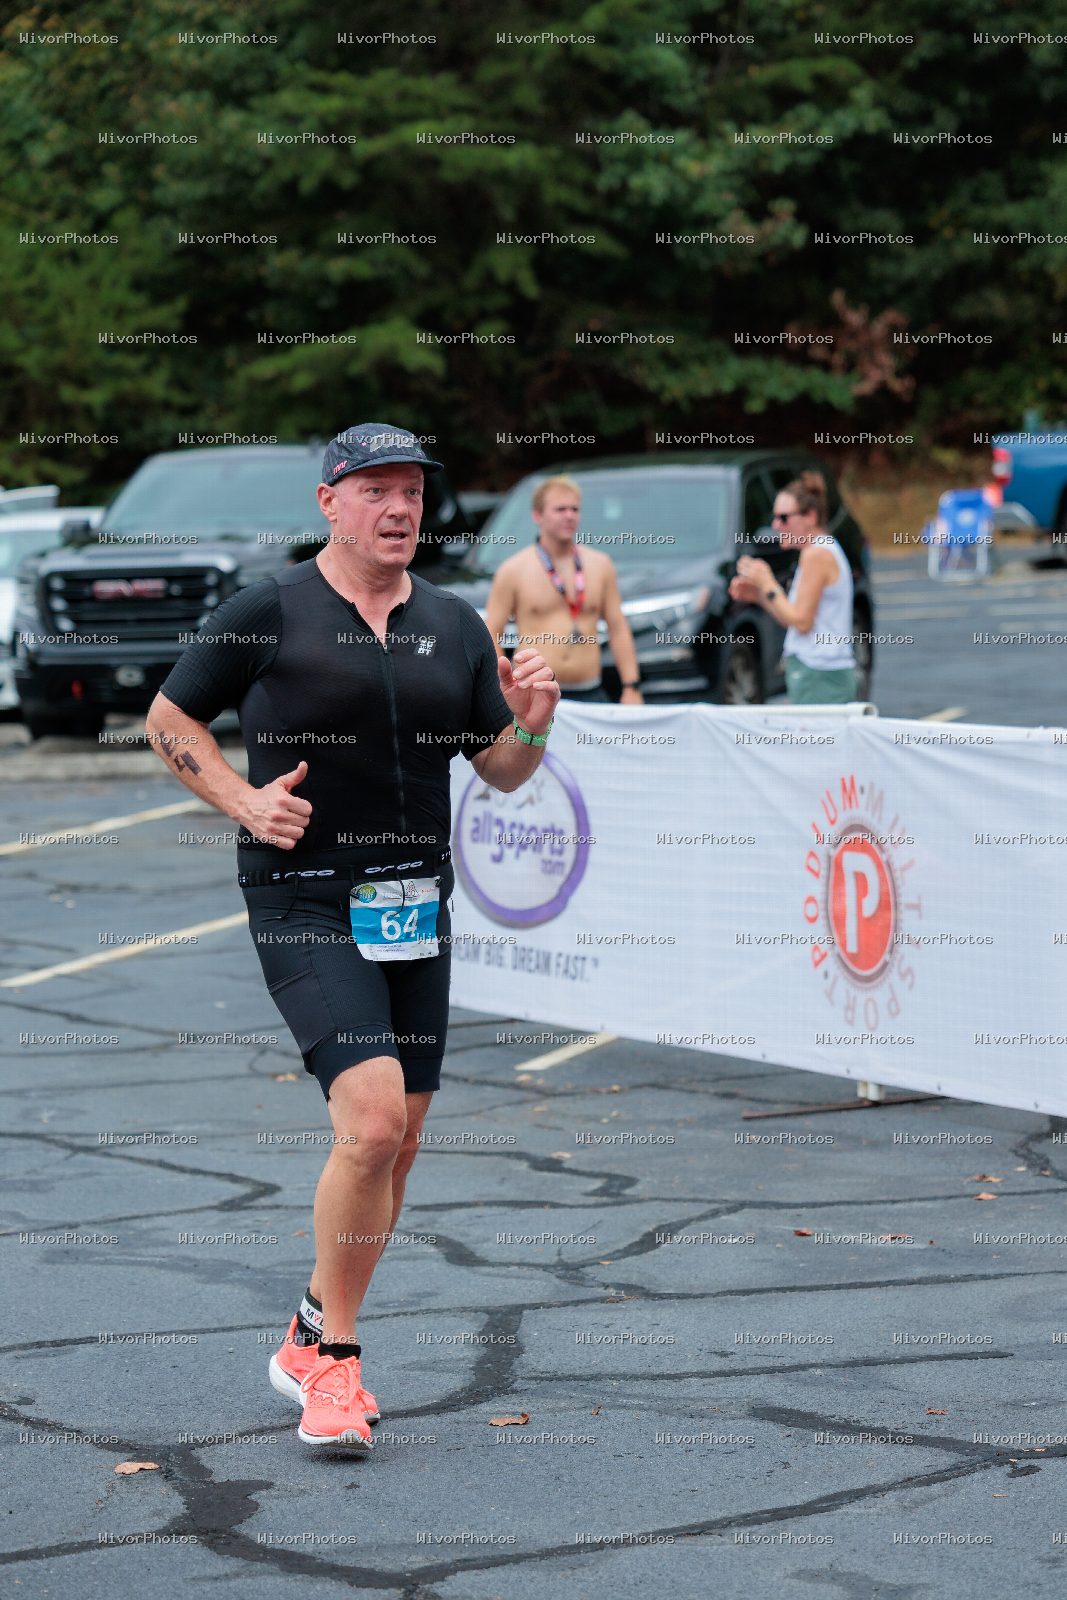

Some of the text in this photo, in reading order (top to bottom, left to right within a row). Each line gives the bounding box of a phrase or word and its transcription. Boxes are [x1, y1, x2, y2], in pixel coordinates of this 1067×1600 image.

[843, 850, 881, 955] P
[381, 908, 419, 941] 64
[511, 945, 552, 977] DREAM
